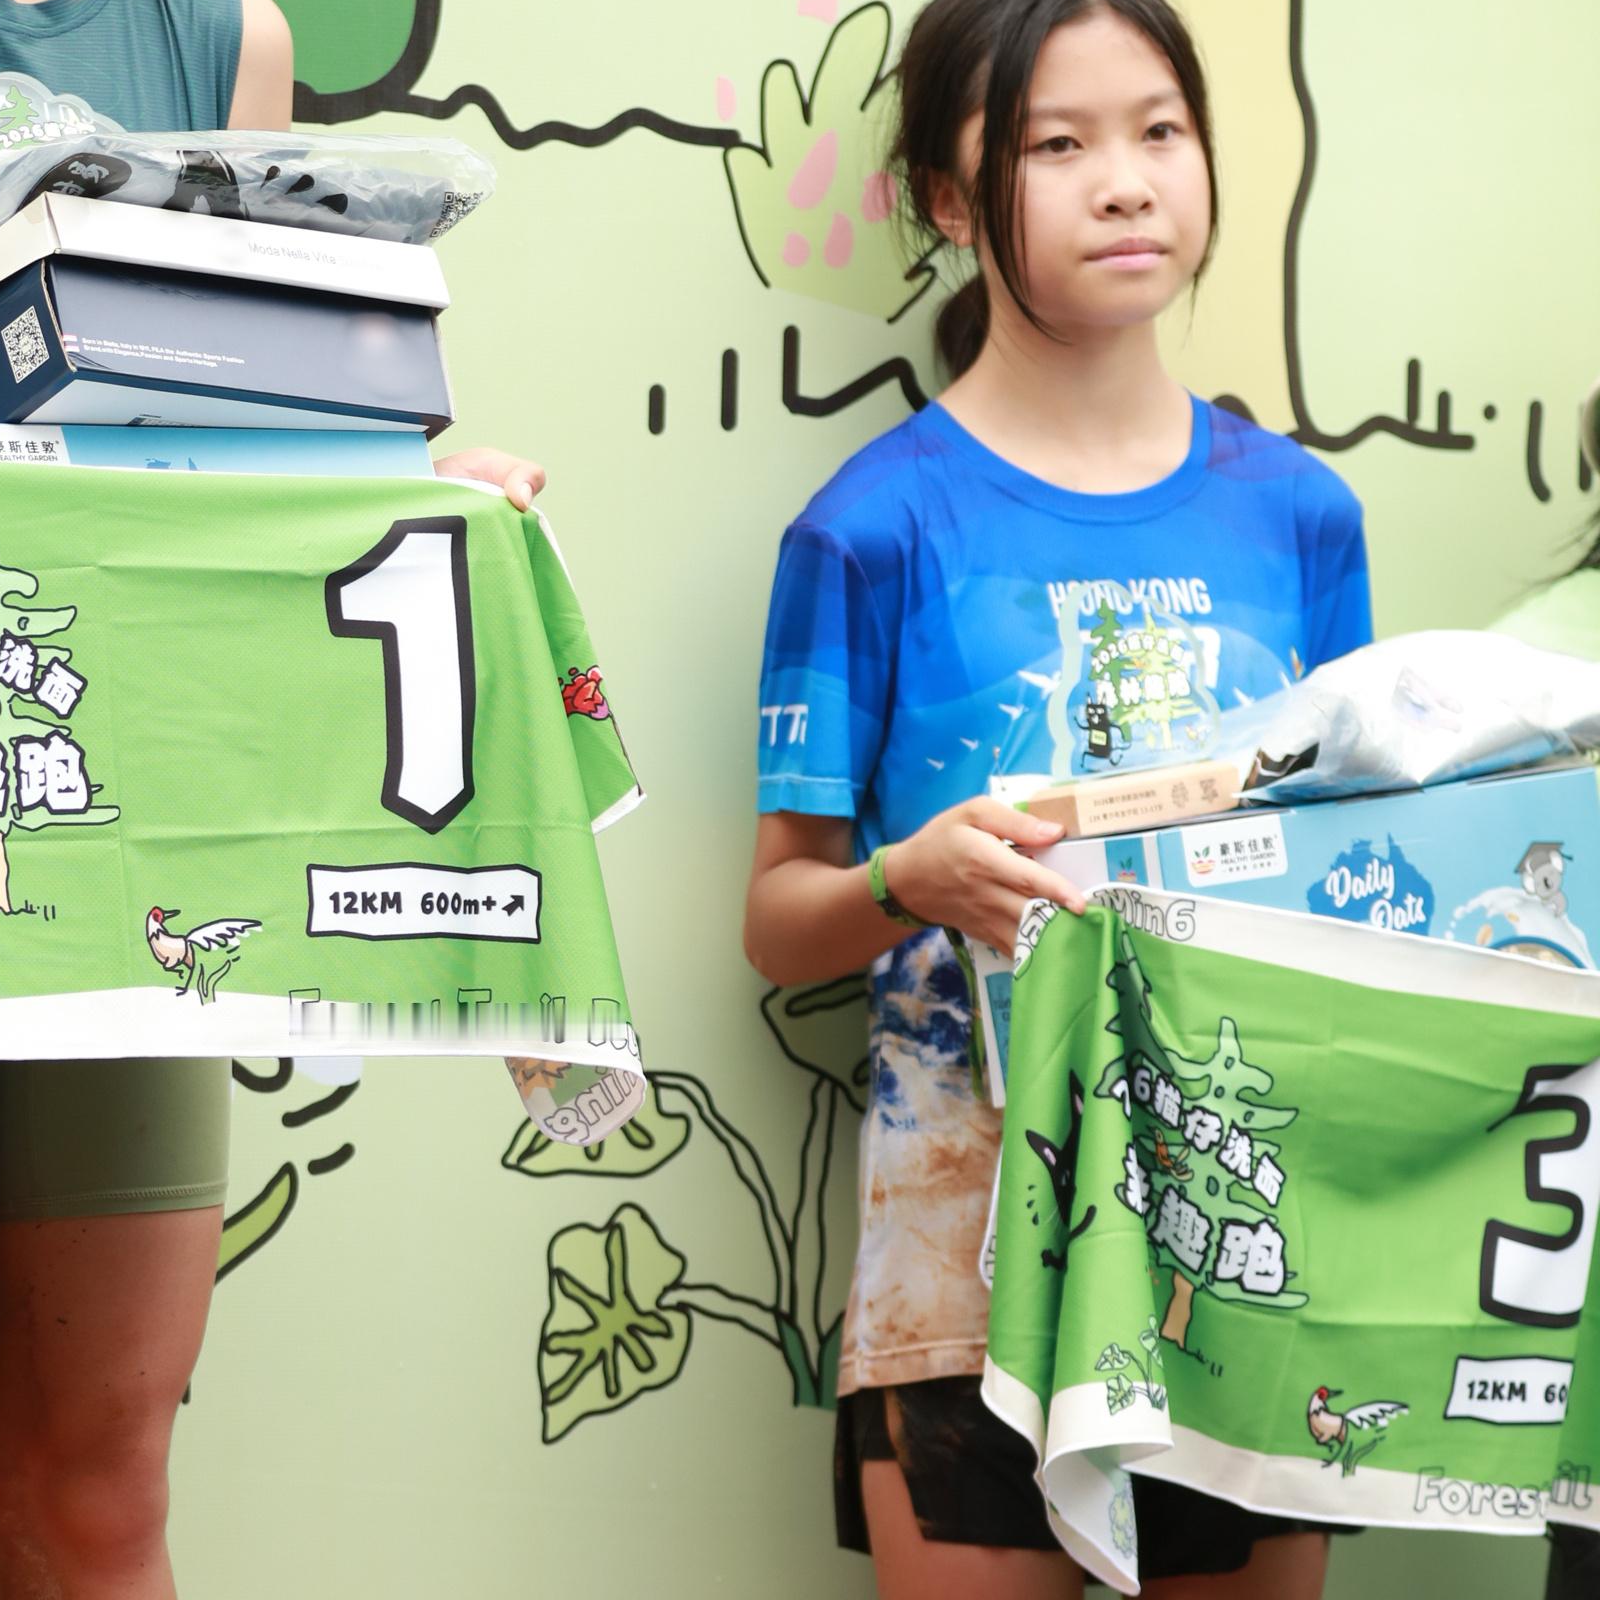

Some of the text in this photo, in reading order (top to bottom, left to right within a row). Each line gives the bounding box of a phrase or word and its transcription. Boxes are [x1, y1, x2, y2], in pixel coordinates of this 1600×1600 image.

[1128, 576, 1213, 615] KONG
[324, 515, 475, 836] 1
[1325, 858, 1395, 909] Daily
[328, 890, 498, 918] 12KM 600m+
[1371, 892, 1427, 931] Oats
[1479, 1064, 1598, 1329] 3
[1467, 1380, 1527, 1403] 12KM
